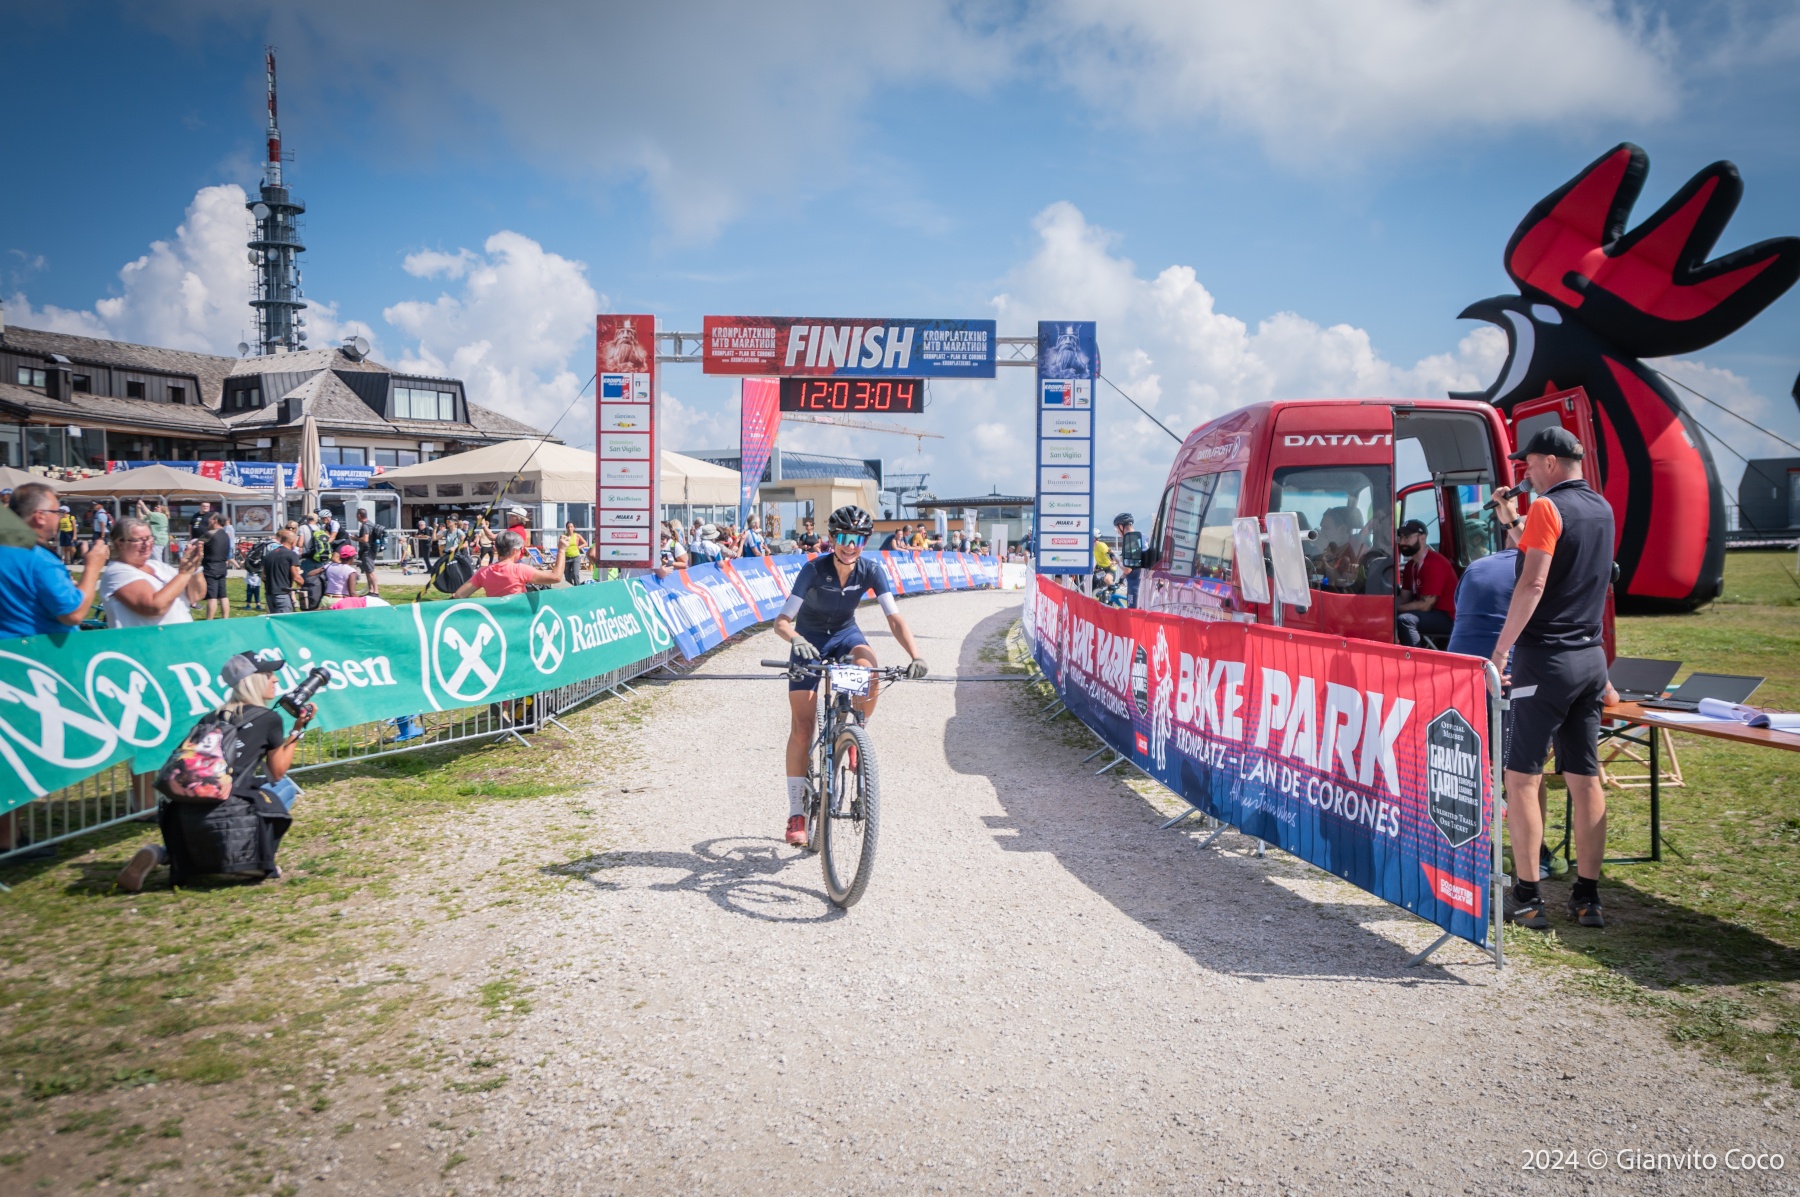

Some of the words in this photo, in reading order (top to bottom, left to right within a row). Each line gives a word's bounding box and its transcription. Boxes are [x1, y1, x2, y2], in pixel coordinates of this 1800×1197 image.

[711, 327, 776, 339] KRONPLATZKING
[711, 338, 730, 348] MTB
[731, 338, 776, 349] MARATHON
[923, 330, 988, 342] KRONPLATZKING
[784, 325, 915, 369] FINISH
[923, 341, 941, 351] MTB
[943, 341, 988, 352] MARATHON
[621, 445, 642, 453] Vigilio
[1062, 451, 1082, 460] Vigilio
[566, 606, 642, 654] Raiffeisen
[1175, 650, 1247, 742] BIKE
[1254, 666, 1416, 797] PARK
[1430, 743, 1477, 779] GRAVITY
[1176, 726, 1227, 770] KRONPLATZ
[1240, 753, 1278, 789] LAN
[1281, 765, 1301, 799] DE
[1307, 776, 1401, 838] CORONES
[1430, 768, 1459, 802] CARD
